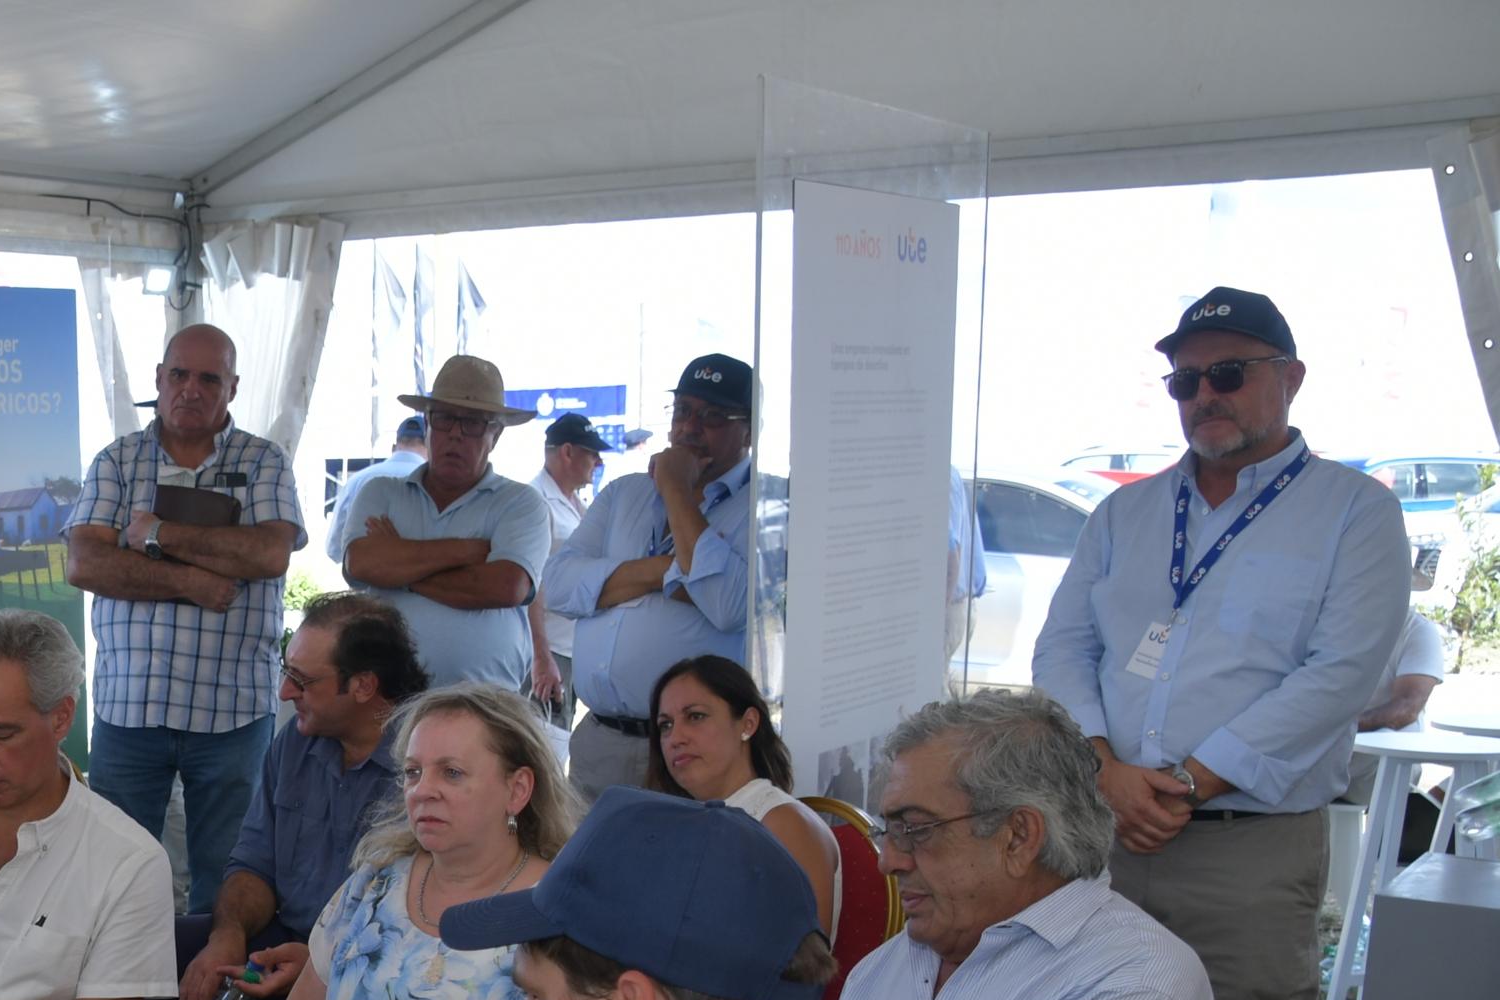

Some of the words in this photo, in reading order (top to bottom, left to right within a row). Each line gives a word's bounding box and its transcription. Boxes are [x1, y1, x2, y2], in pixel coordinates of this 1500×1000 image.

[852, 229, 882, 259] AÑOS
[897, 227, 928, 264] ute
[1192, 303, 1231, 321] ute
[694, 366, 723, 383] ute
[1274, 474, 1291, 491] ute
[1245, 503, 1262, 520] ute
[1217, 533, 1233, 551] ute
[1190, 567, 1207, 586] ute
